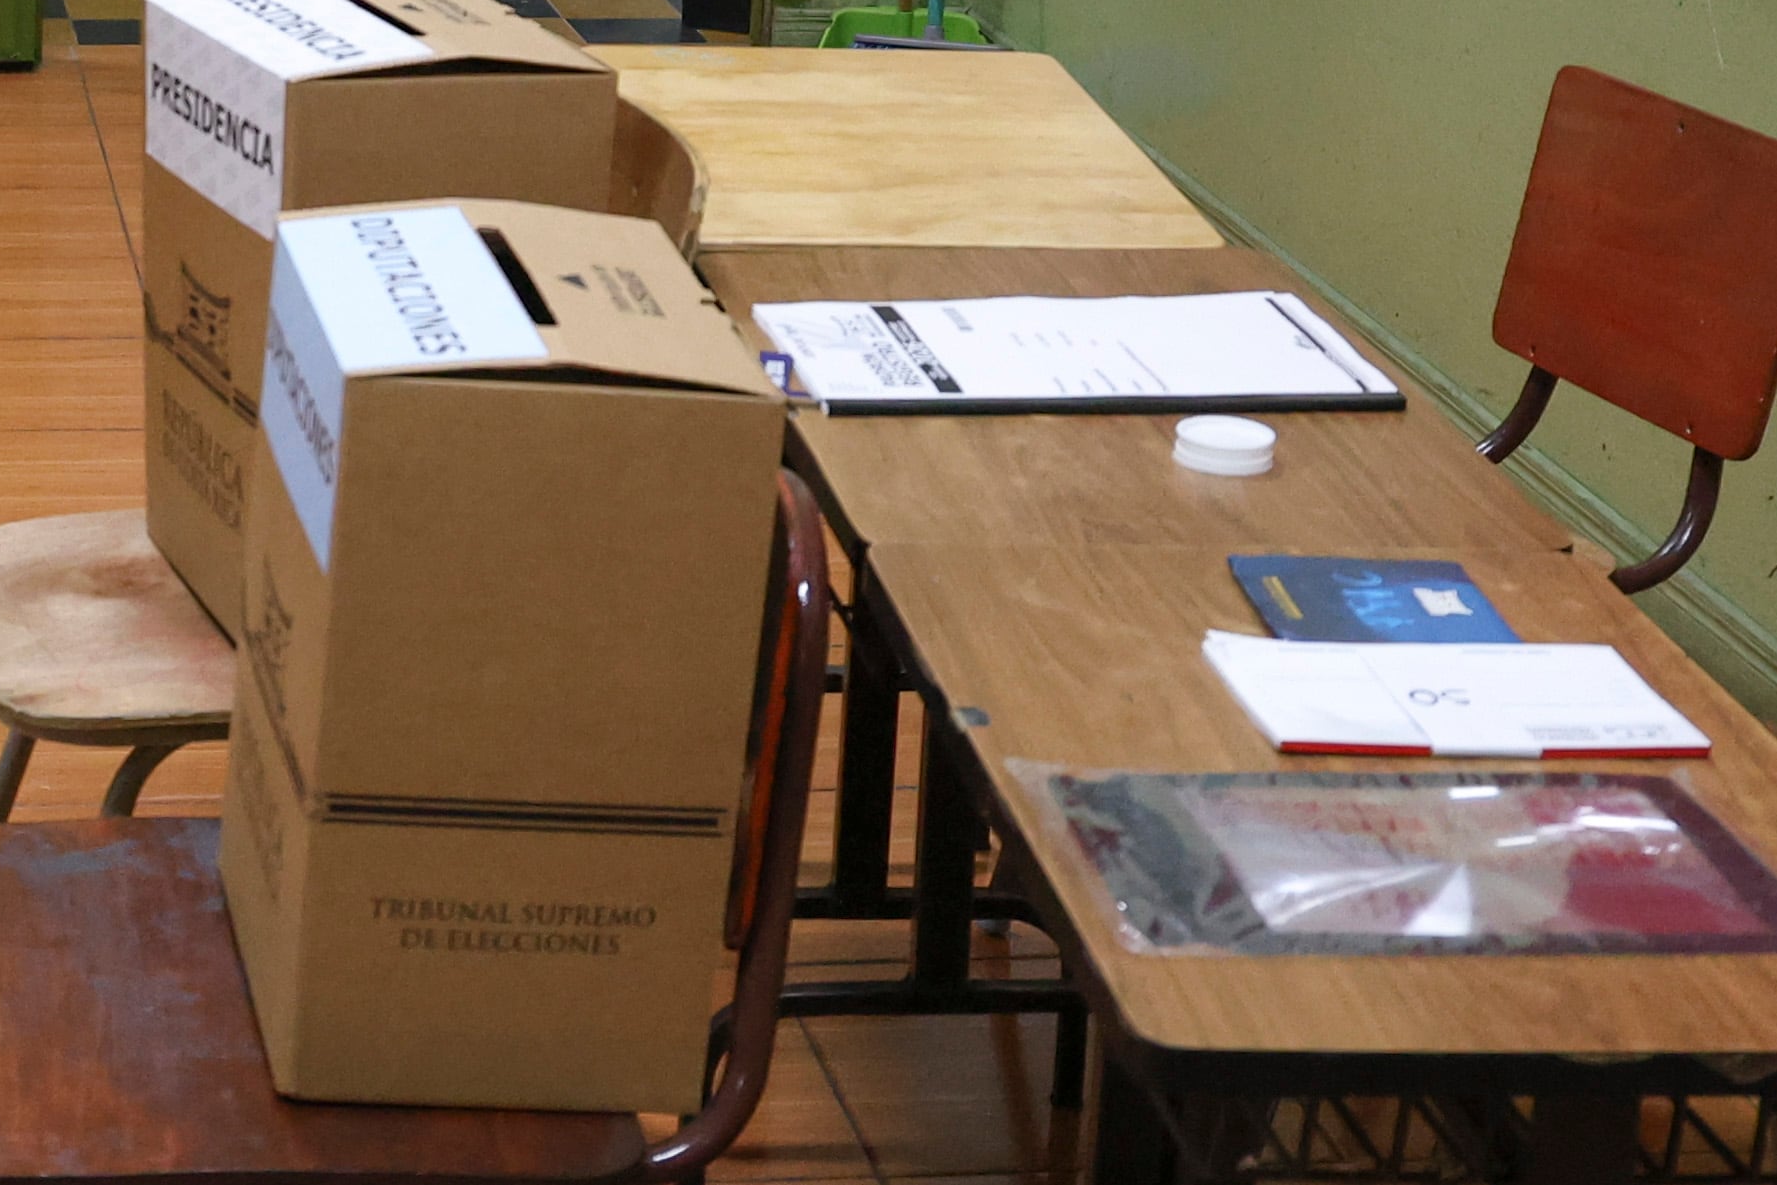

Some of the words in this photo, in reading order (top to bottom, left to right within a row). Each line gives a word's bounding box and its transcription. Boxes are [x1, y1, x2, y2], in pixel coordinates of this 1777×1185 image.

[150, 62, 275, 176] PRESIDENCIA
[351, 217, 467, 355] DIPUTACIONES
[370, 895, 512, 925] TRIBUNAL
[521, 902, 658, 928] SUPREMO
[400, 927, 437, 951] DE
[447, 928, 621, 956] ELECCIONES
